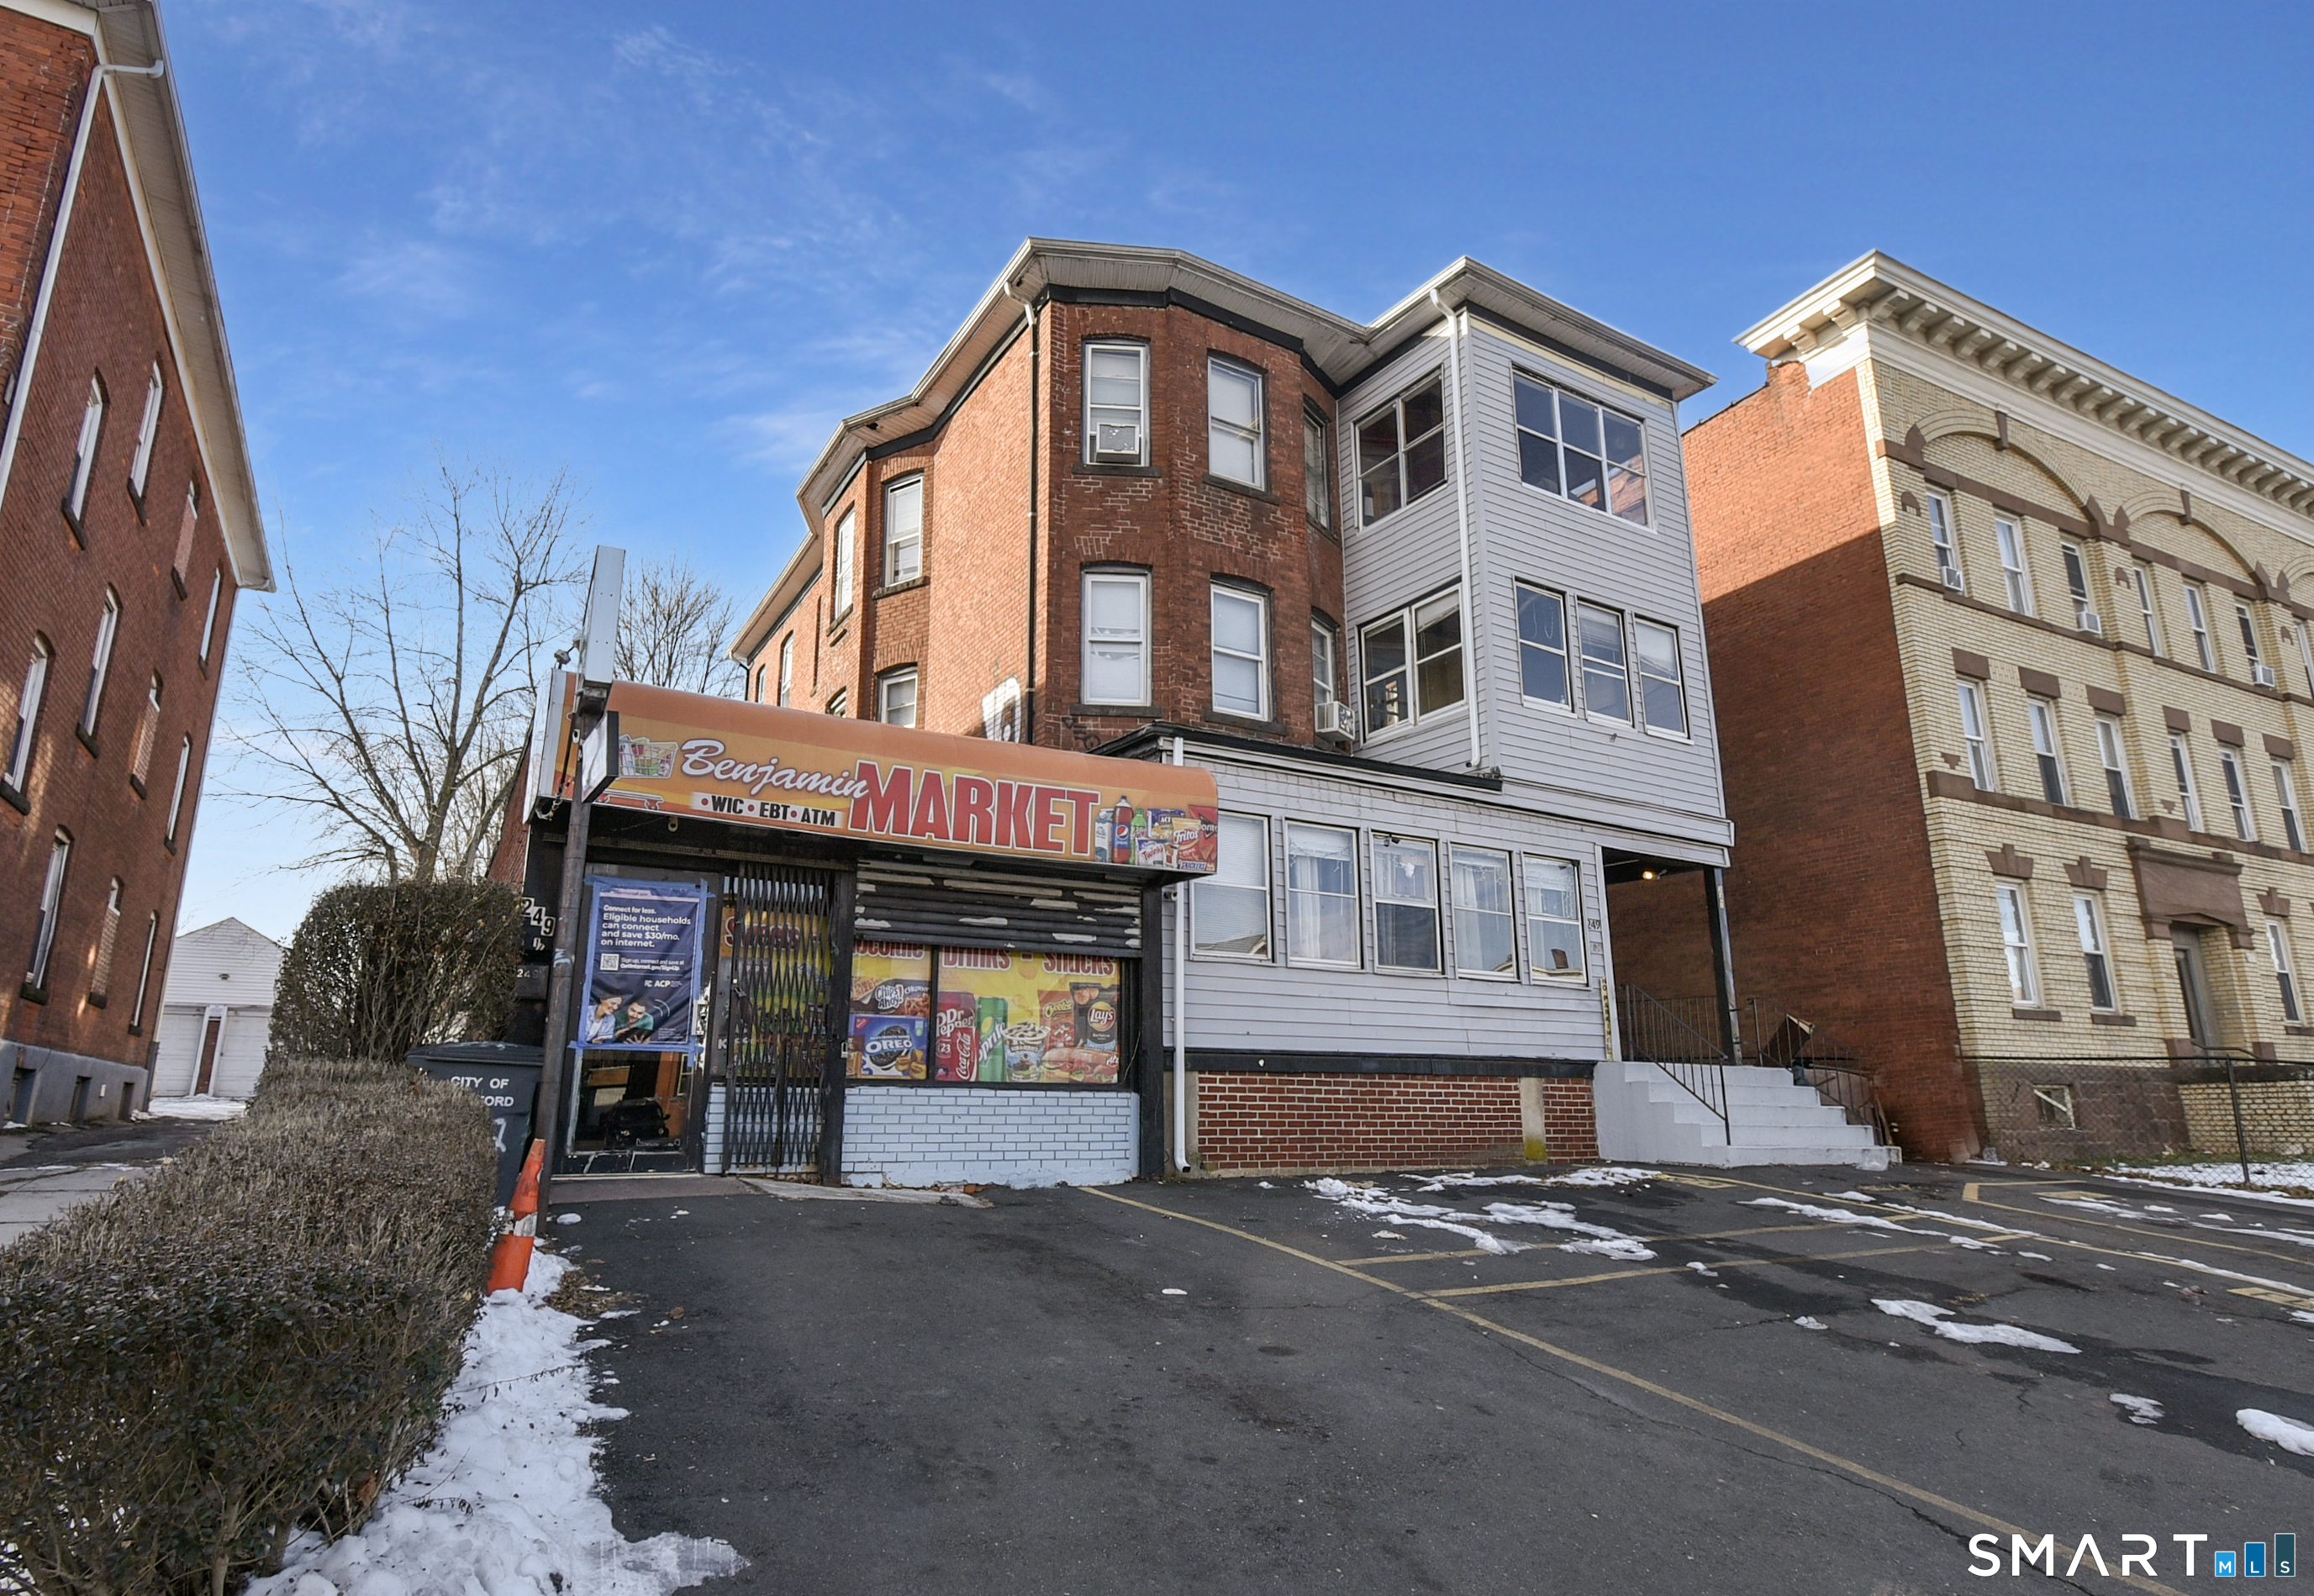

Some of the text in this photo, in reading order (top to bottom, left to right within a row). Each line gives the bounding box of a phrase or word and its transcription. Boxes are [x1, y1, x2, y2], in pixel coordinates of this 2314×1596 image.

[681, 740, 1100, 856] Benjamin MARKET
[711, 795, 835, 826] WIC EBT ATM
[1173, 829, 1199, 844] Fritos
[604, 904, 630, 913] Connect
[520, 898, 555, 935] 249
[604, 913, 691, 924] Eligible households
[1588, 919, 1601, 930] 249
[645, 931, 680, 940] $30/mo.
[615, 939, 655, 948] internet.
[946, 1009, 964, 1023] Dr
[1043, 999, 1074, 1020] Cheetos
[1090, 1009, 1114, 1025] Lay's
[936, 1012, 973, 1037] Pepper
[866, 1040, 913, 1053] OREO
[941, 1043, 951, 1054] 23
[451, 1076, 509, 1089] CITY OF
[481, 1096, 514, 1107] ORD
